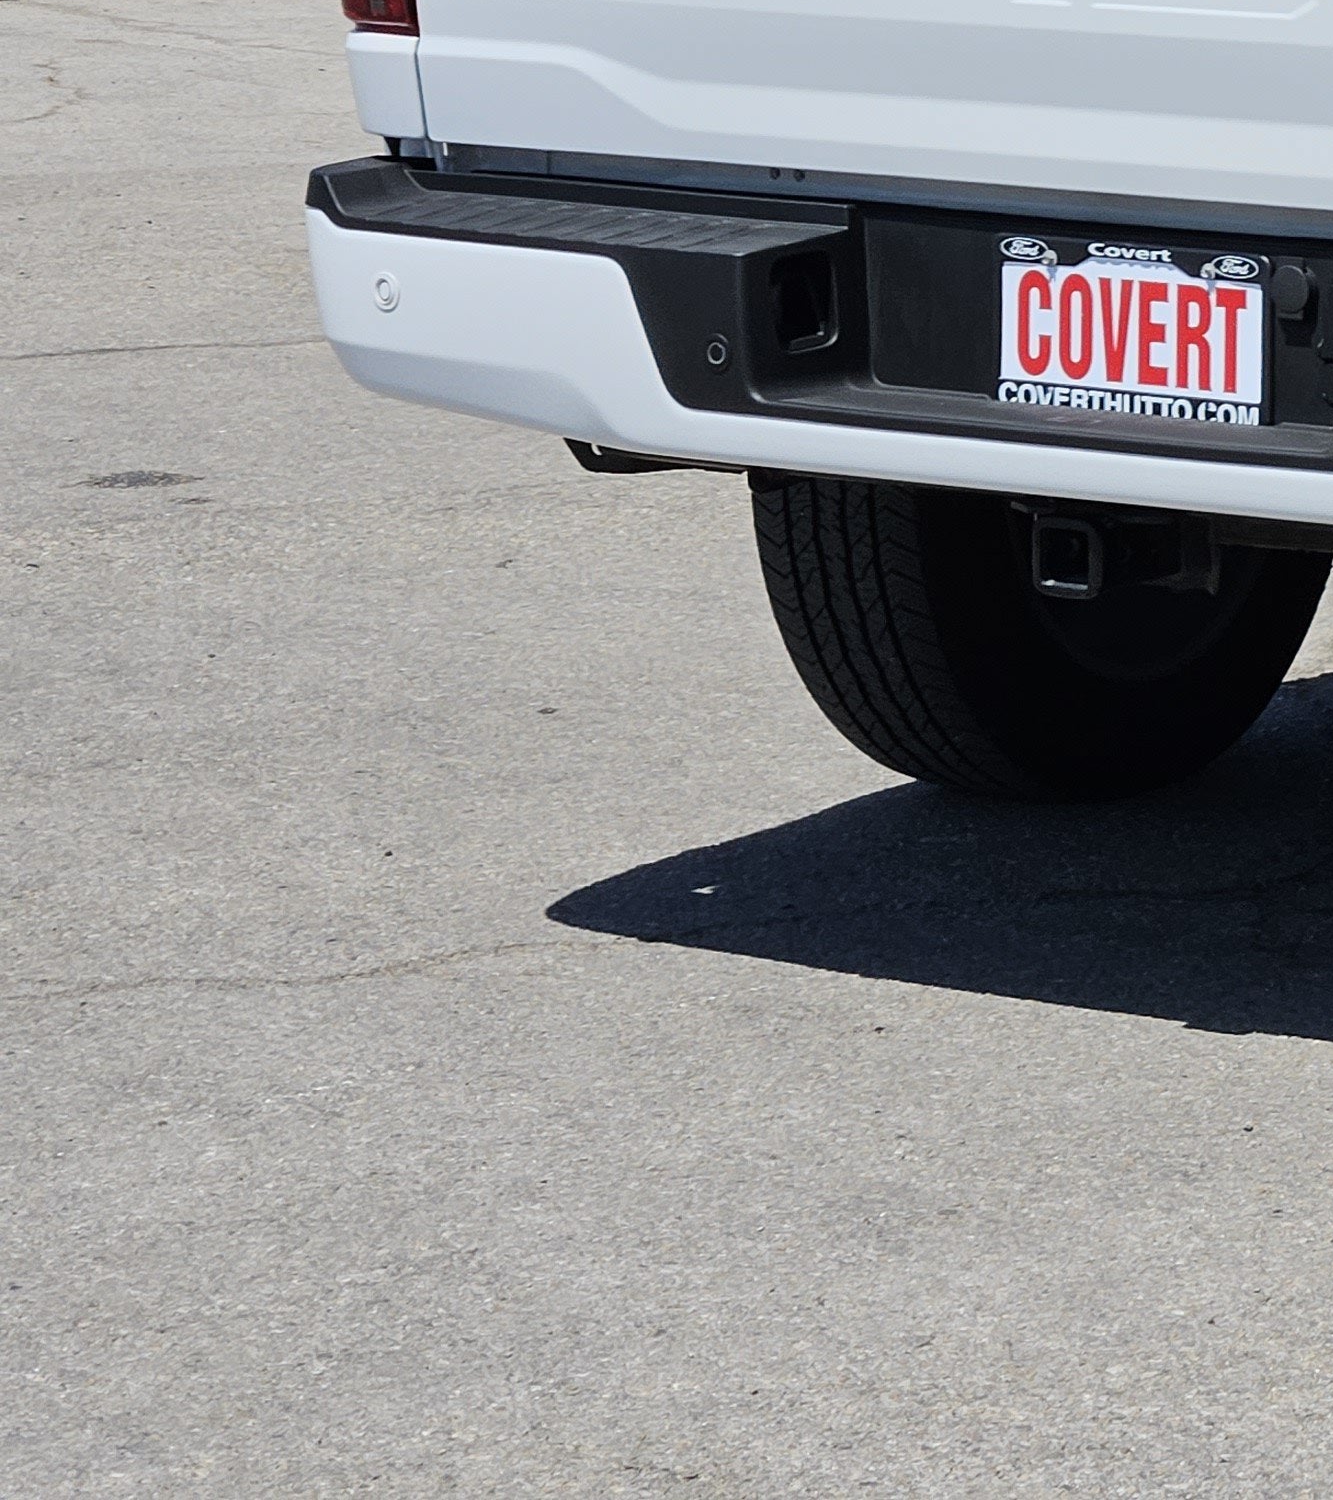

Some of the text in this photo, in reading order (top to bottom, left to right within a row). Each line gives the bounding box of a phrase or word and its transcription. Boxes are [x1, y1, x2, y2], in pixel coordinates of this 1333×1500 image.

[1087, 242, 1172, 262] Covert
[1018, 269, 1247, 393] COVERT
[997, 381, 1259, 426] COVERTHUTTOCOM
